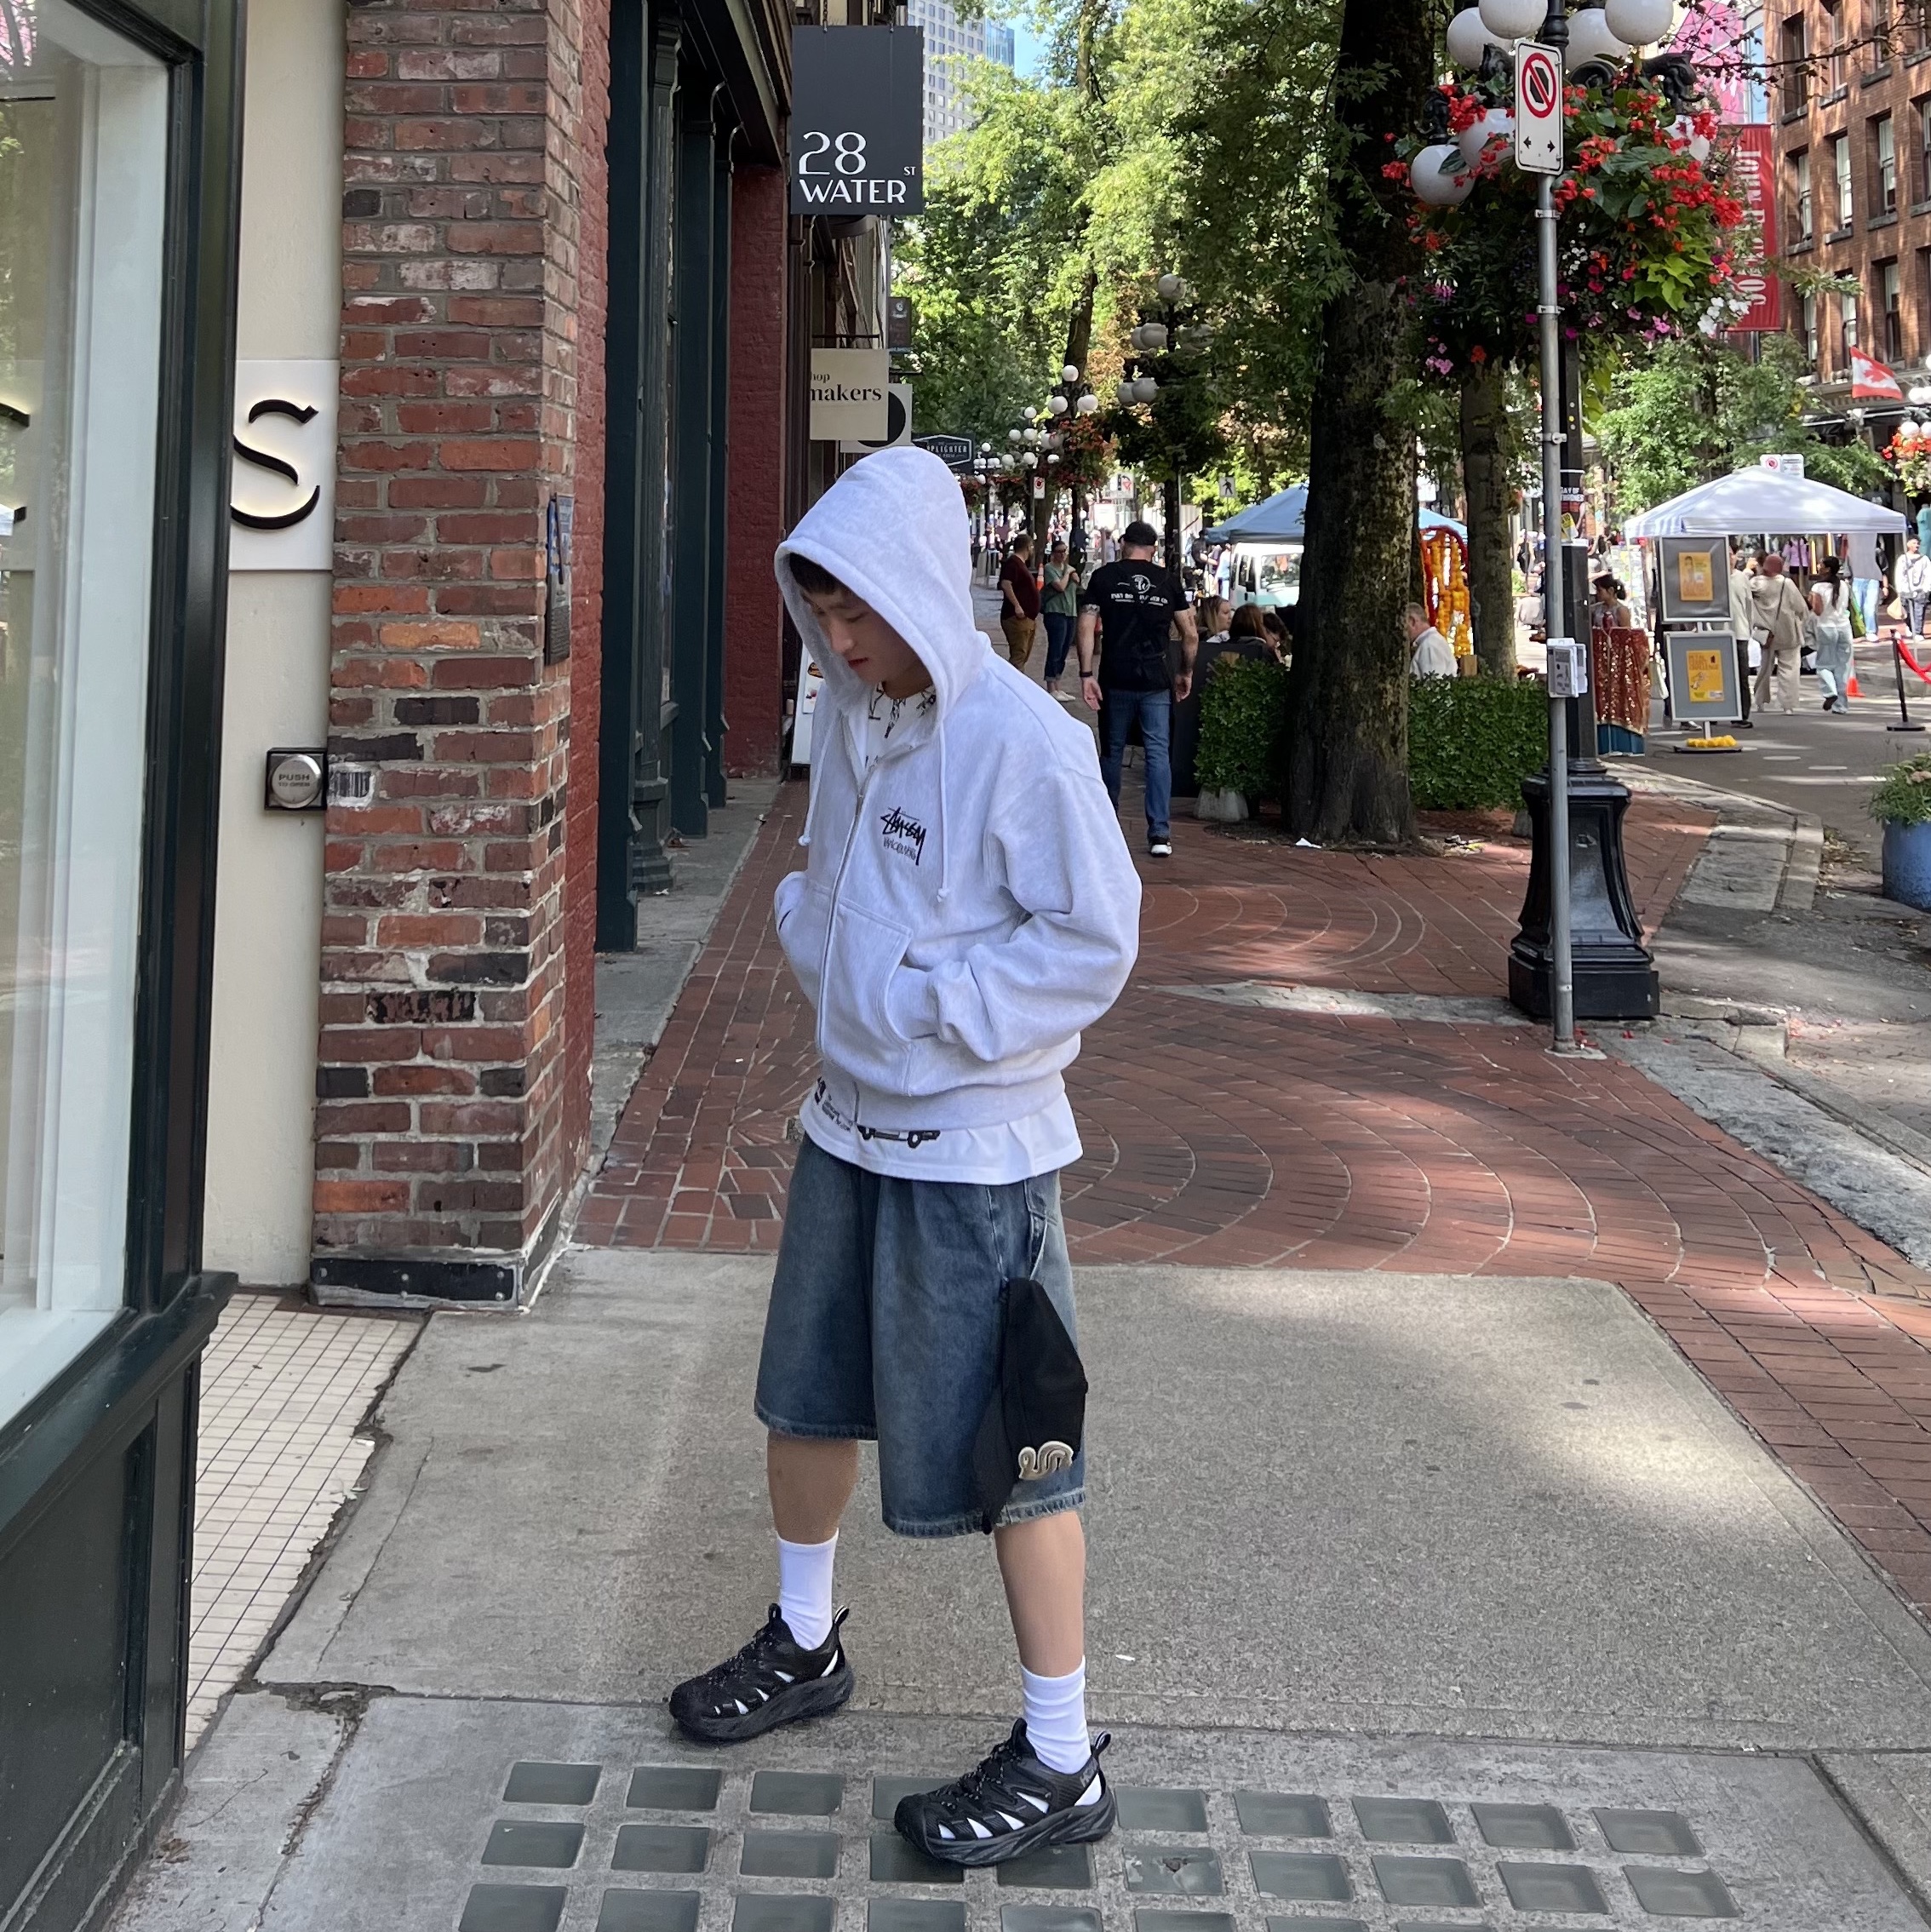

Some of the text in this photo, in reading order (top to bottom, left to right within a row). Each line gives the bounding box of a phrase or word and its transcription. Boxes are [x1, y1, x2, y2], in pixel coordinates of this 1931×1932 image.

[799, 131, 867, 175] 28
[903, 166, 916, 176] ST
[799, 179, 907, 204] WATER
